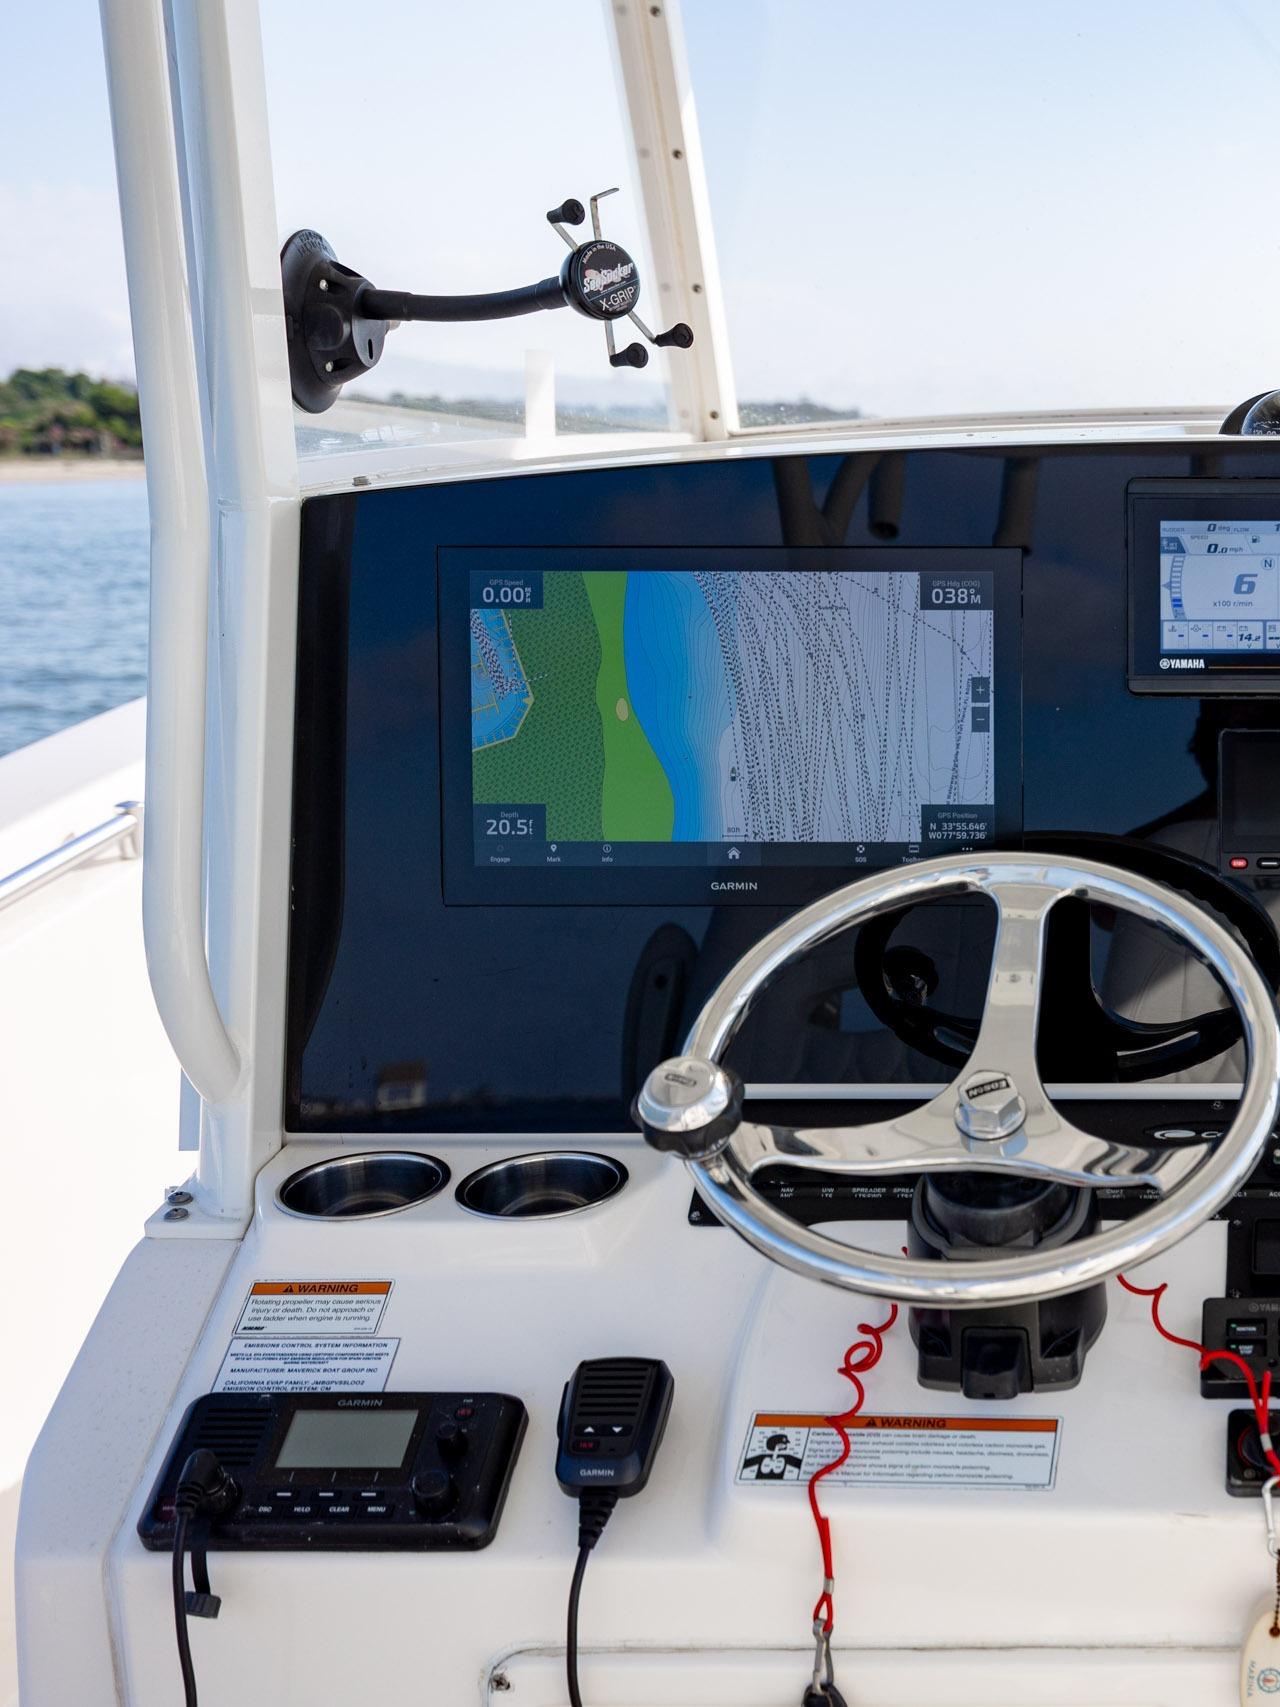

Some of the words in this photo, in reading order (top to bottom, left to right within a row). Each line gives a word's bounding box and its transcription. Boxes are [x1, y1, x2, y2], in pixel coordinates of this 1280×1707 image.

[606, 243, 616, 252] USA
[600, 288, 635, 311] X-GRIP
[1234, 574, 1258, 594] 6
[482, 587, 524, 603] 0.00
[1170, 659, 1205, 668] YAMAHA
[486, 819, 528, 835] 20.5
[710, 882, 757, 891] GARMIN
[298, 1284, 358, 1292] WARNING
[881, 1418, 946, 1428] WARNING
